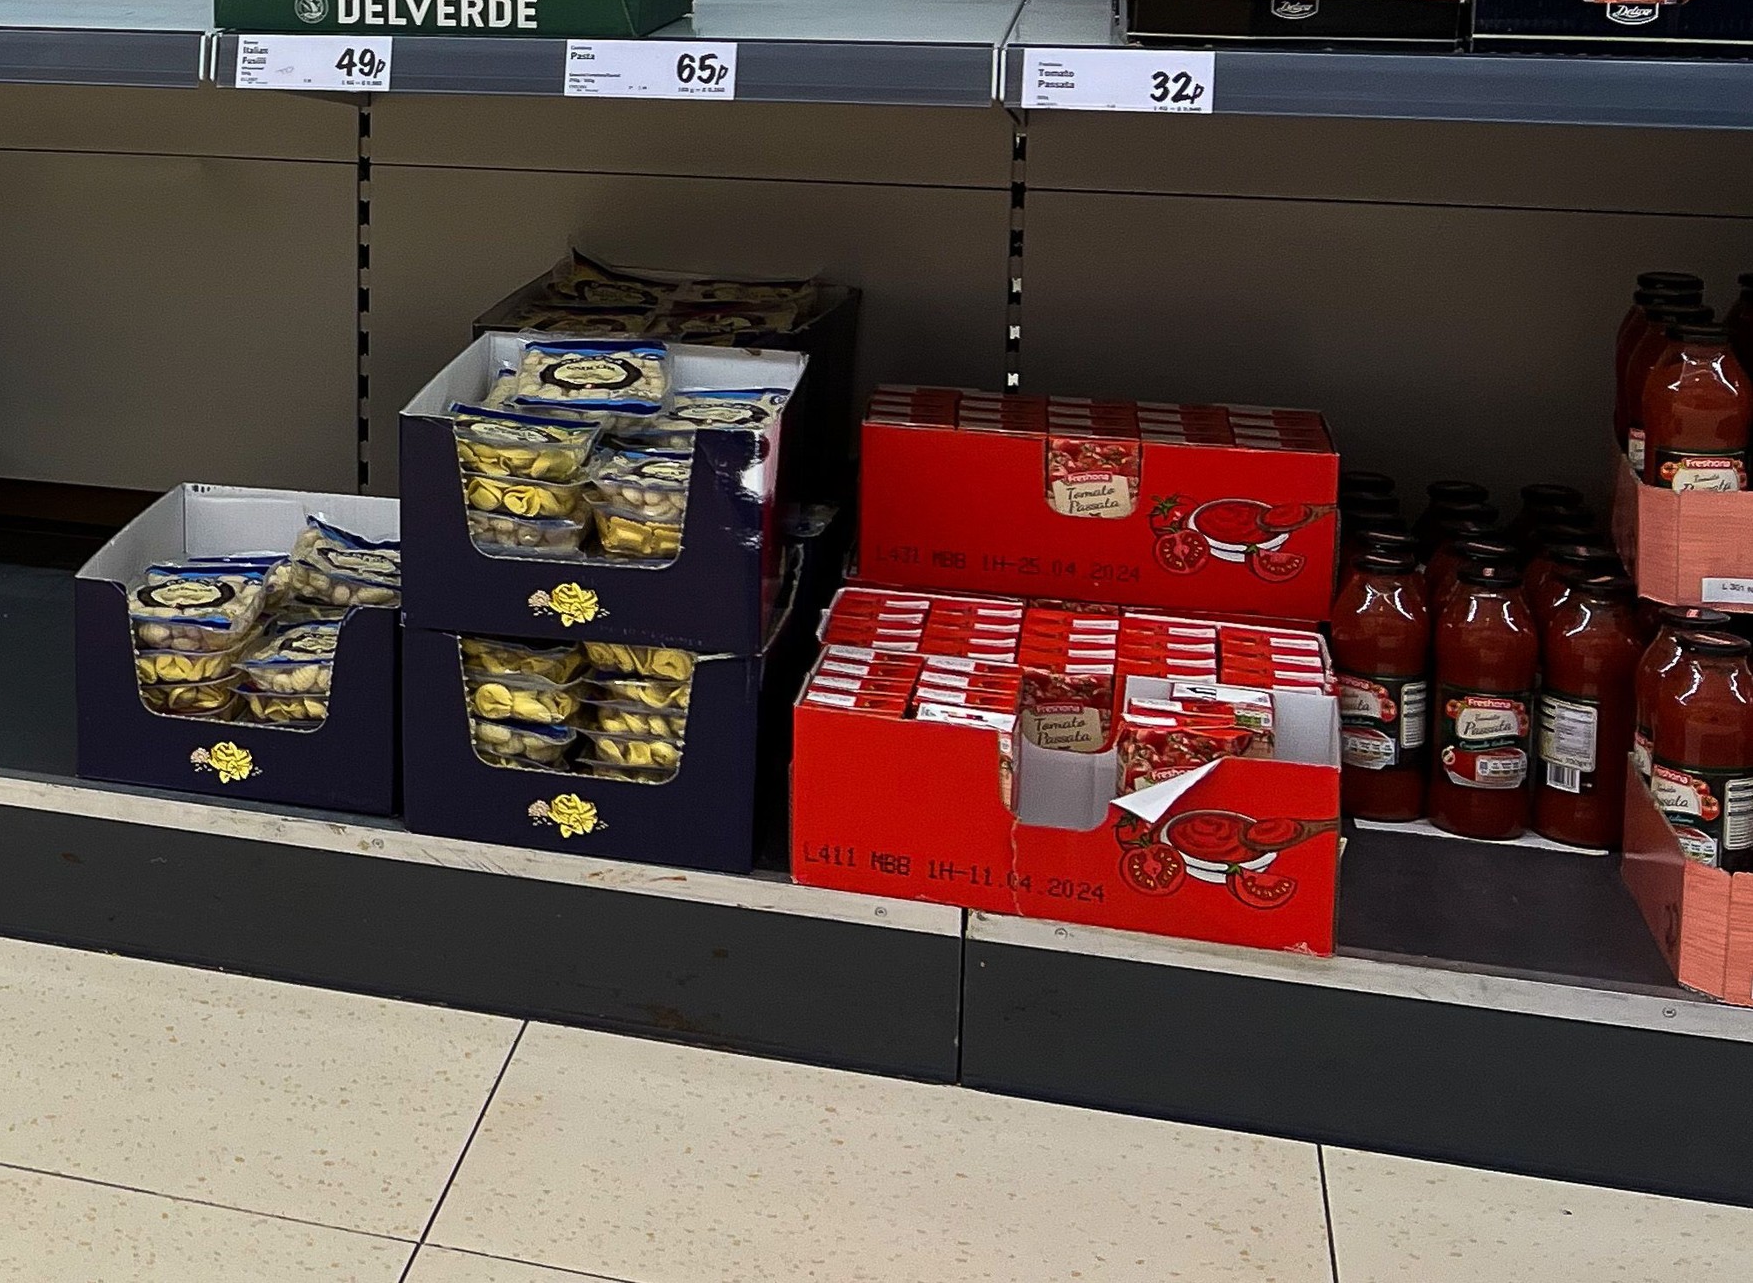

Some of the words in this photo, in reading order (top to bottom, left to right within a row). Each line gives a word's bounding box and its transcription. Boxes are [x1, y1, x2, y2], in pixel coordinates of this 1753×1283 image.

[1277, 1, 1313, 14] Deluxe
[1612, 5, 1653, 17] Deluxe
[335, 48, 386, 78] 49p
[570, 52, 595, 60] Pasta
[677, 53, 729, 85] 65p
[1038, 69, 1075, 77] Tomato
[1037, 80, 1075, 89] Passata
[1150, 71, 1205, 104] 32p
[1686, 459, 1731, 468] Freshona
[1067, 474, 1110, 482] Freshona
[1066, 485, 1115, 500] Tomato
[1069, 498, 1119, 514] Passata
[874, 546, 919, 564] L431
[1036, 704, 1081, 714] Freshona
[1468, 698, 1511, 709] Freshona
[1034, 717, 1086, 731] Tomato
[1463, 721, 1512, 736] Passata
[1037, 731, 1091, 745] Passata
[803, 841, 855, 866] L411
